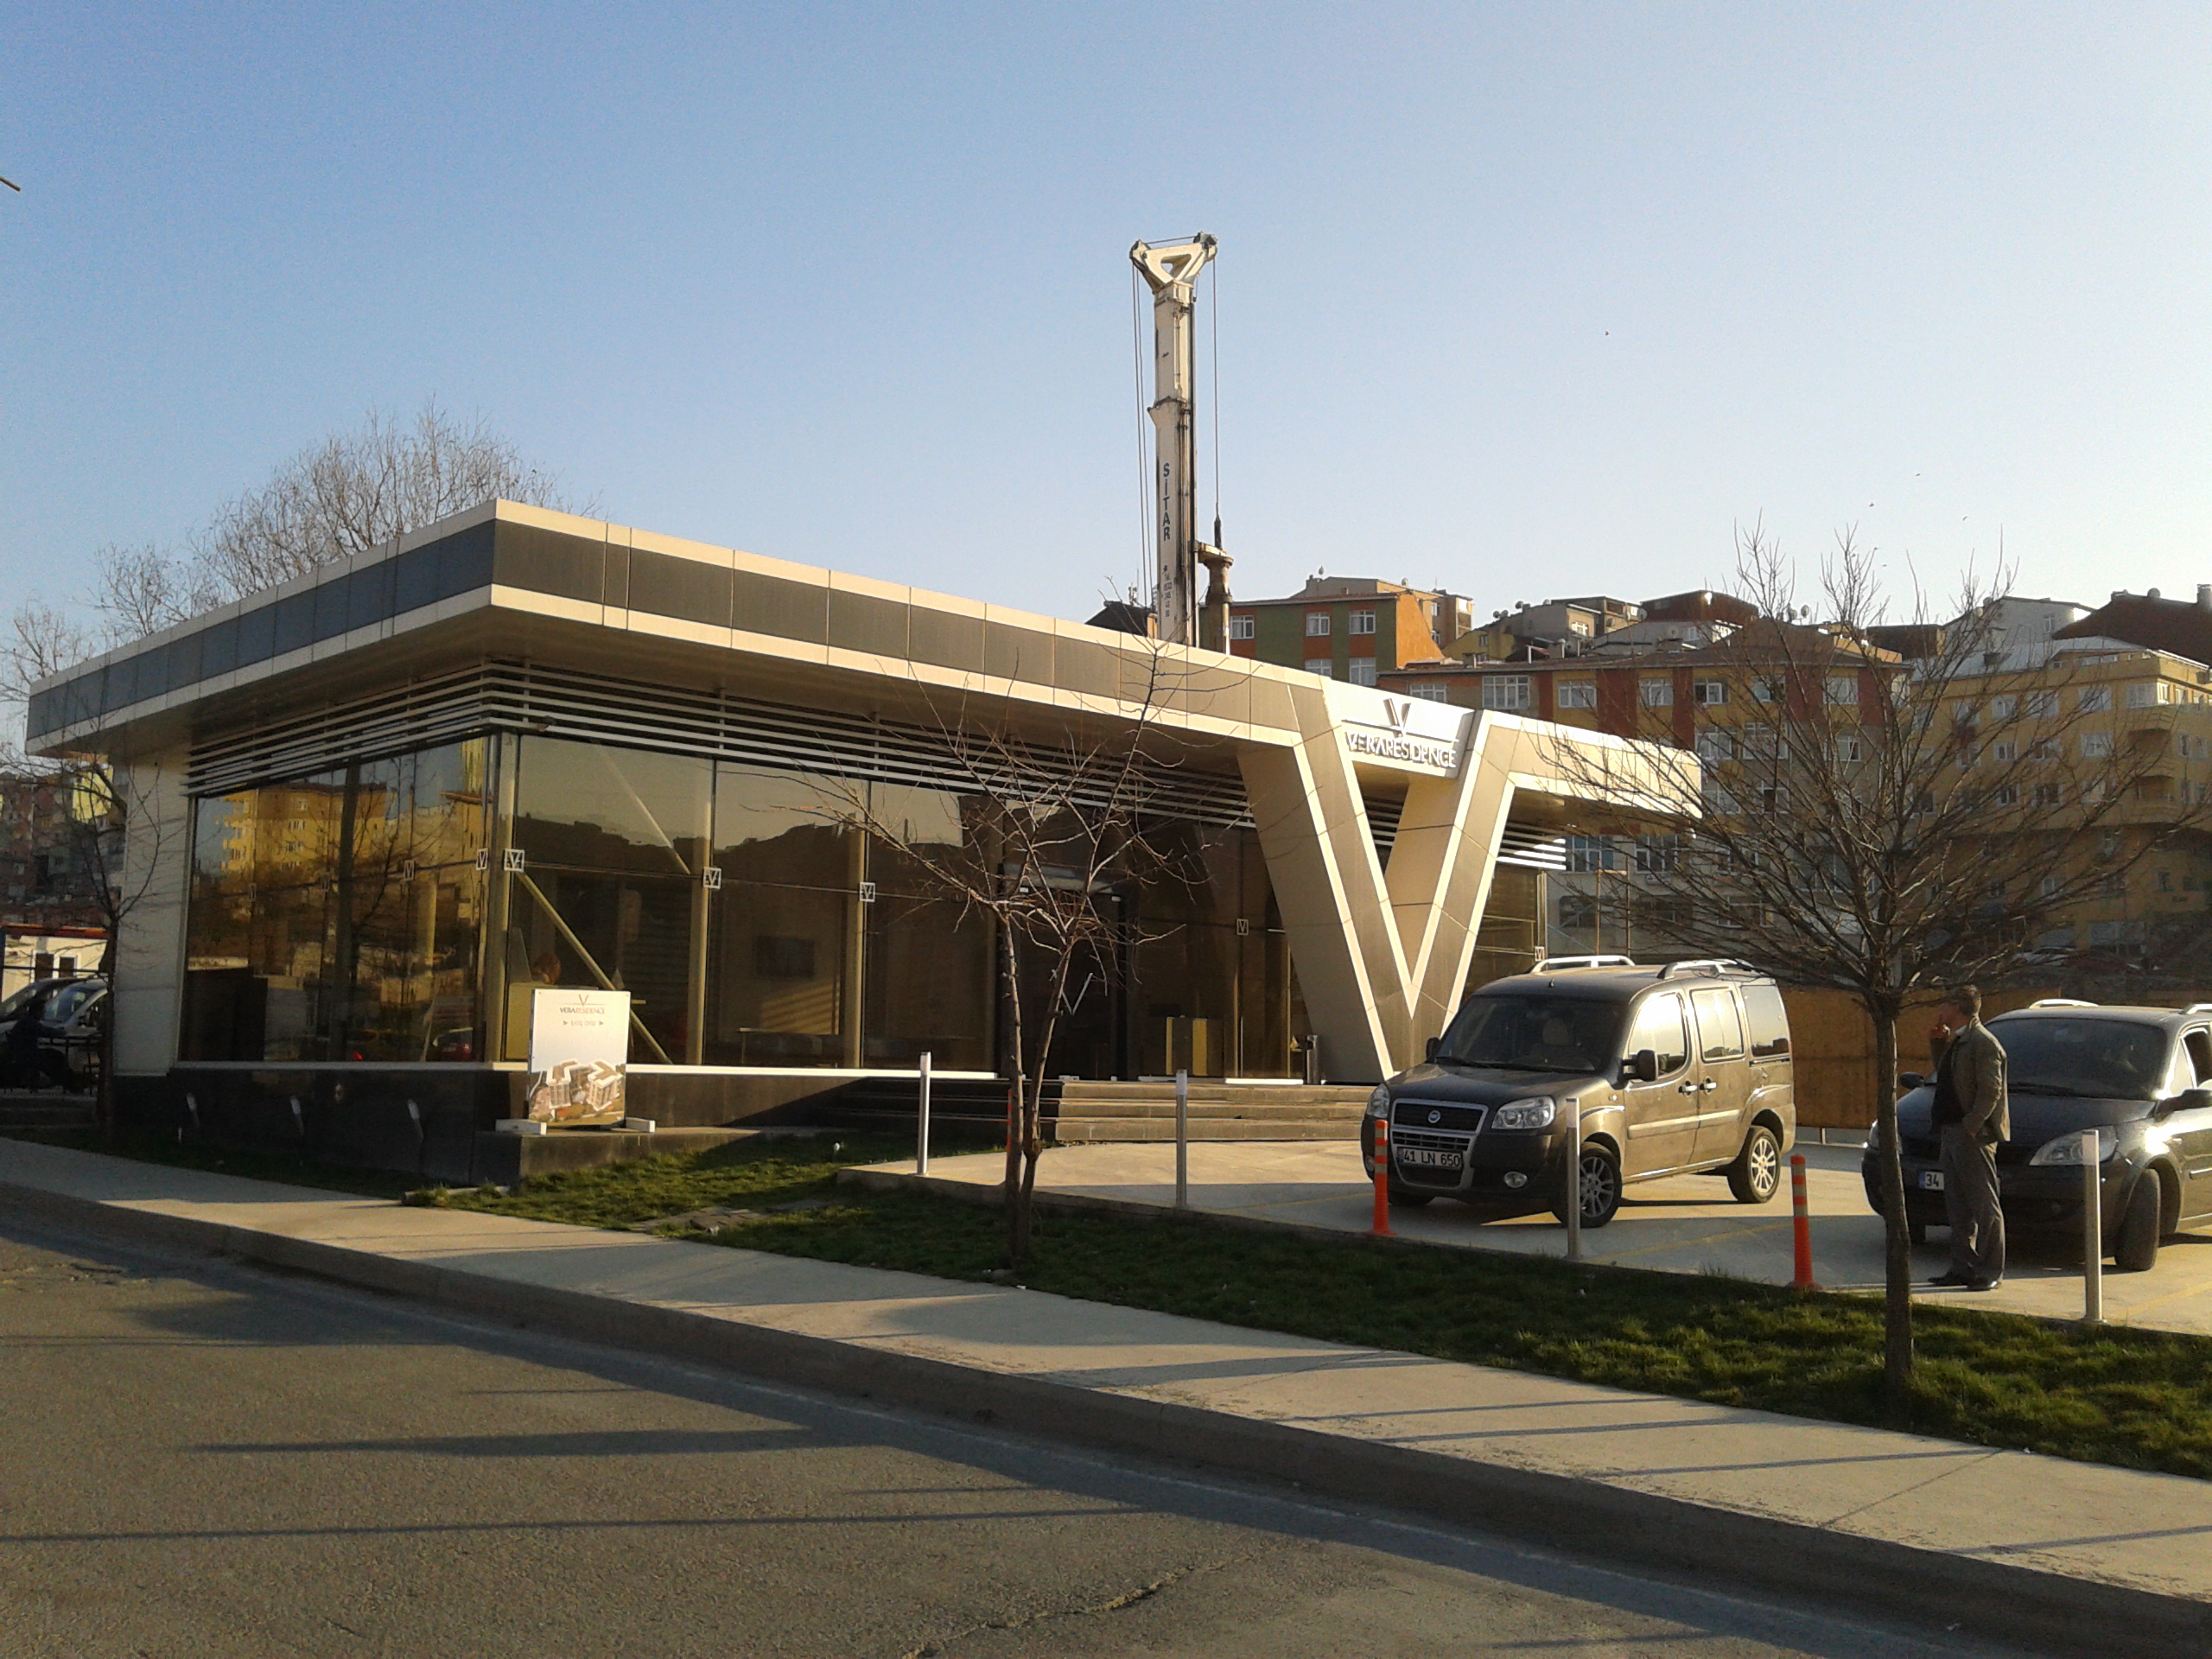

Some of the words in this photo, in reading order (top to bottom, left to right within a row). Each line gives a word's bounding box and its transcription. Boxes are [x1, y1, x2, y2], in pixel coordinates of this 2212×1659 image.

[1404, 1150, 1416, 1162] 41
[1421, 1151, 1435, 1165] LN
[1440, 1154, 1460, 1166] 650
[1926, 1173, 1939, 1187] 34
